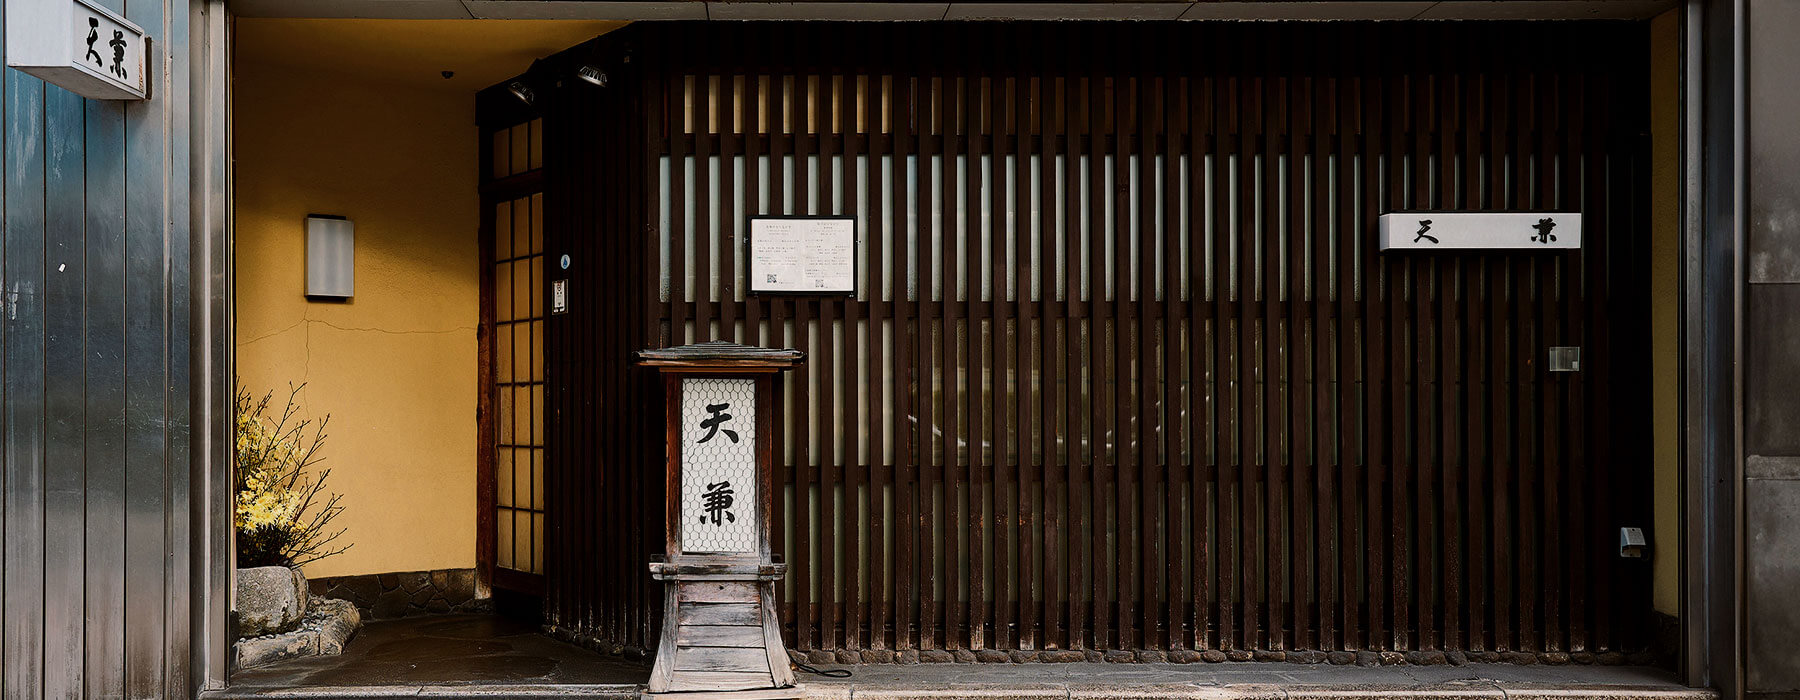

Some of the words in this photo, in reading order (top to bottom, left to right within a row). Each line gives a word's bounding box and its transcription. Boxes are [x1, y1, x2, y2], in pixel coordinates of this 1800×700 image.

[86, 17, 128, 80] 天兼
[1414, 217, 1557, 244] 天兼
[696, 402, 739, 527] 天兼
